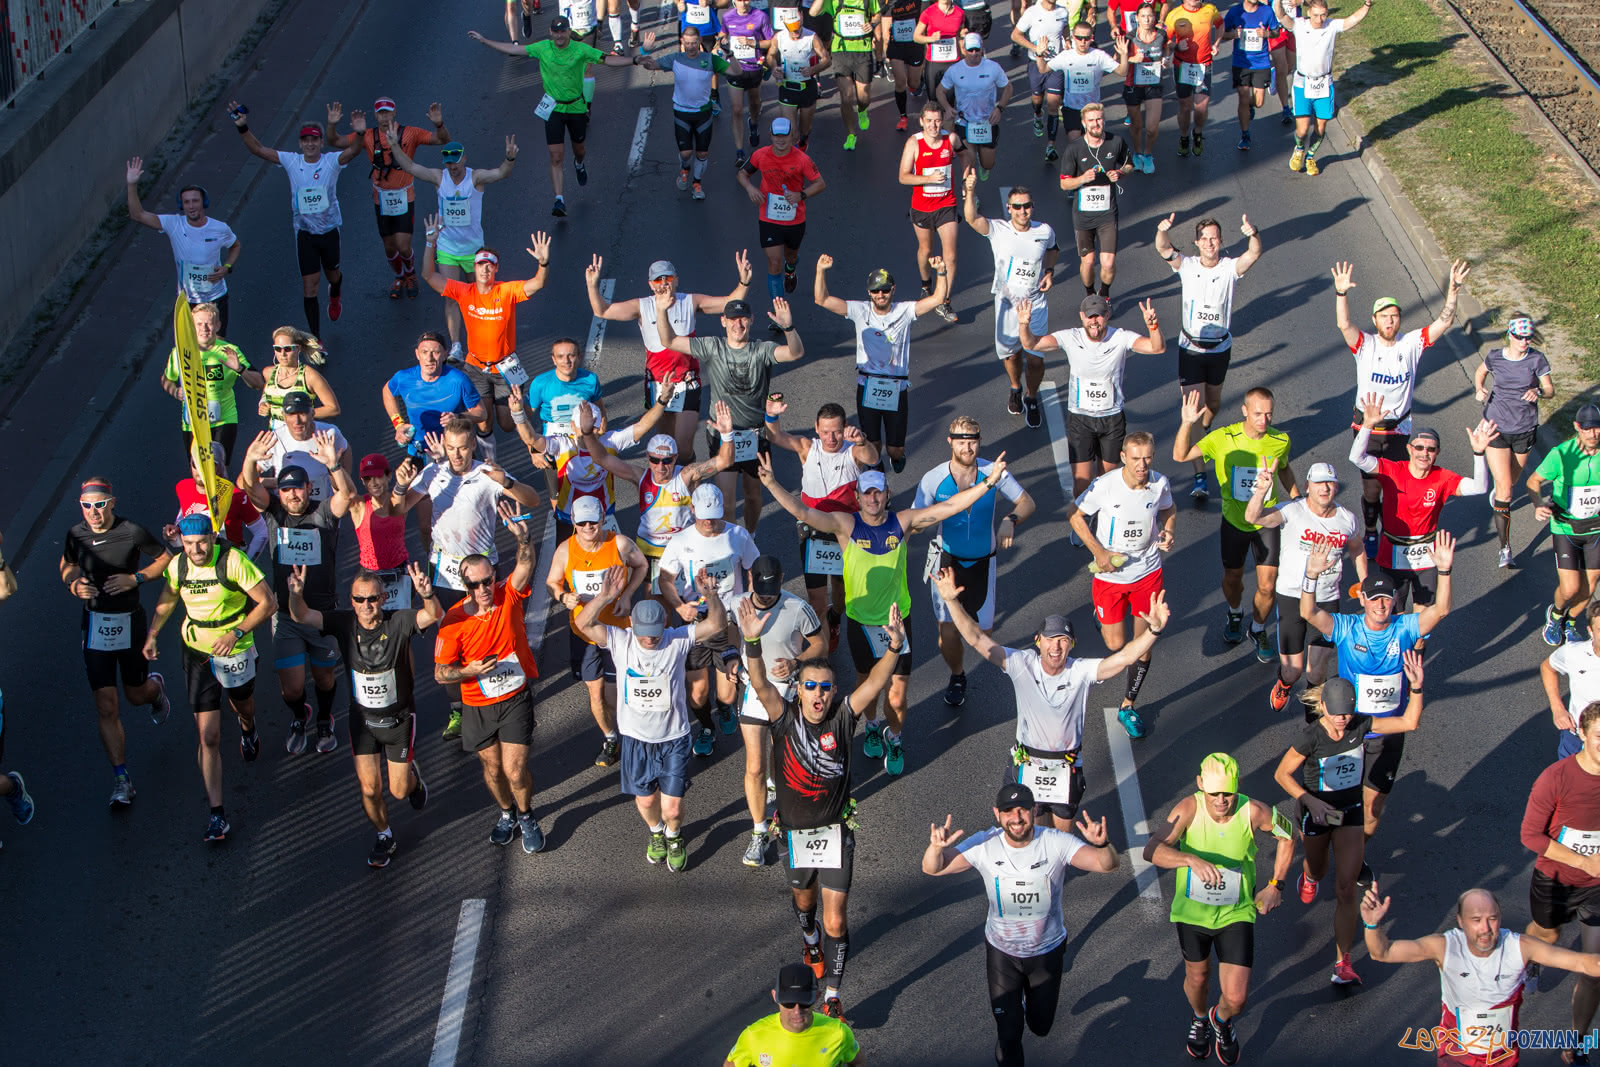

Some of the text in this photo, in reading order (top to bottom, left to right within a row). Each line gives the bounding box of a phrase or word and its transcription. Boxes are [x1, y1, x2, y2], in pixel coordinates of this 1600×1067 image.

[844, 21, 861, 29] 5605
[896, 26, 913, 34] 2690
[1073, 77, 1090, 86] 4136
[1310, 83, 1326, 91] 1609
[973, 127, 989, 136] 1324
[303, 194, 323, 204] 1569
[385, 197, 403, 206] 1334
[1086, 194, 1106, 203] 3398
[446, 207, 467, 217] 2908
[773, 202, 792, 212] 2416
[188, 272, 209, 282] 1958
[1015, 268, 1036, 278] 2346
[1197, 311, 1221, 322] 3208
[1371, 371, 1411, 386] MAHLE
[196, 371, 208, 422] SPLIT
[871, 388, 894, 399] 2759
[1085, 390, 1108, 400] 1656
[735, 440, 753, 450] 379
[1578, 496, 1600, 507] 1401
[1123, 529, 1143, 539] 883
[288, 539, 314, 552] 4481
[1402, 545, 1428, 557] 4665
[815, 549, 843, 562] 5496
[190, 587, 209, 596] TEAM
[97, 625, 124, 637] 4359
[223, 658, 250, 675] 5607
[361, 683, 389, 696] 1523
[633, 687, 663, 699] 5569
[1365, 687, 1396, 699] 9999
[1335, 761, 1356, 776] 752
[1034, 775, 1058, 787] 552
[805, 838, 829, 851] 497
[1571, 842, 1600, 856] 5031
[1010, 891, 1041, 904] 1071
[831, 942, 849, 976] Kalenji
